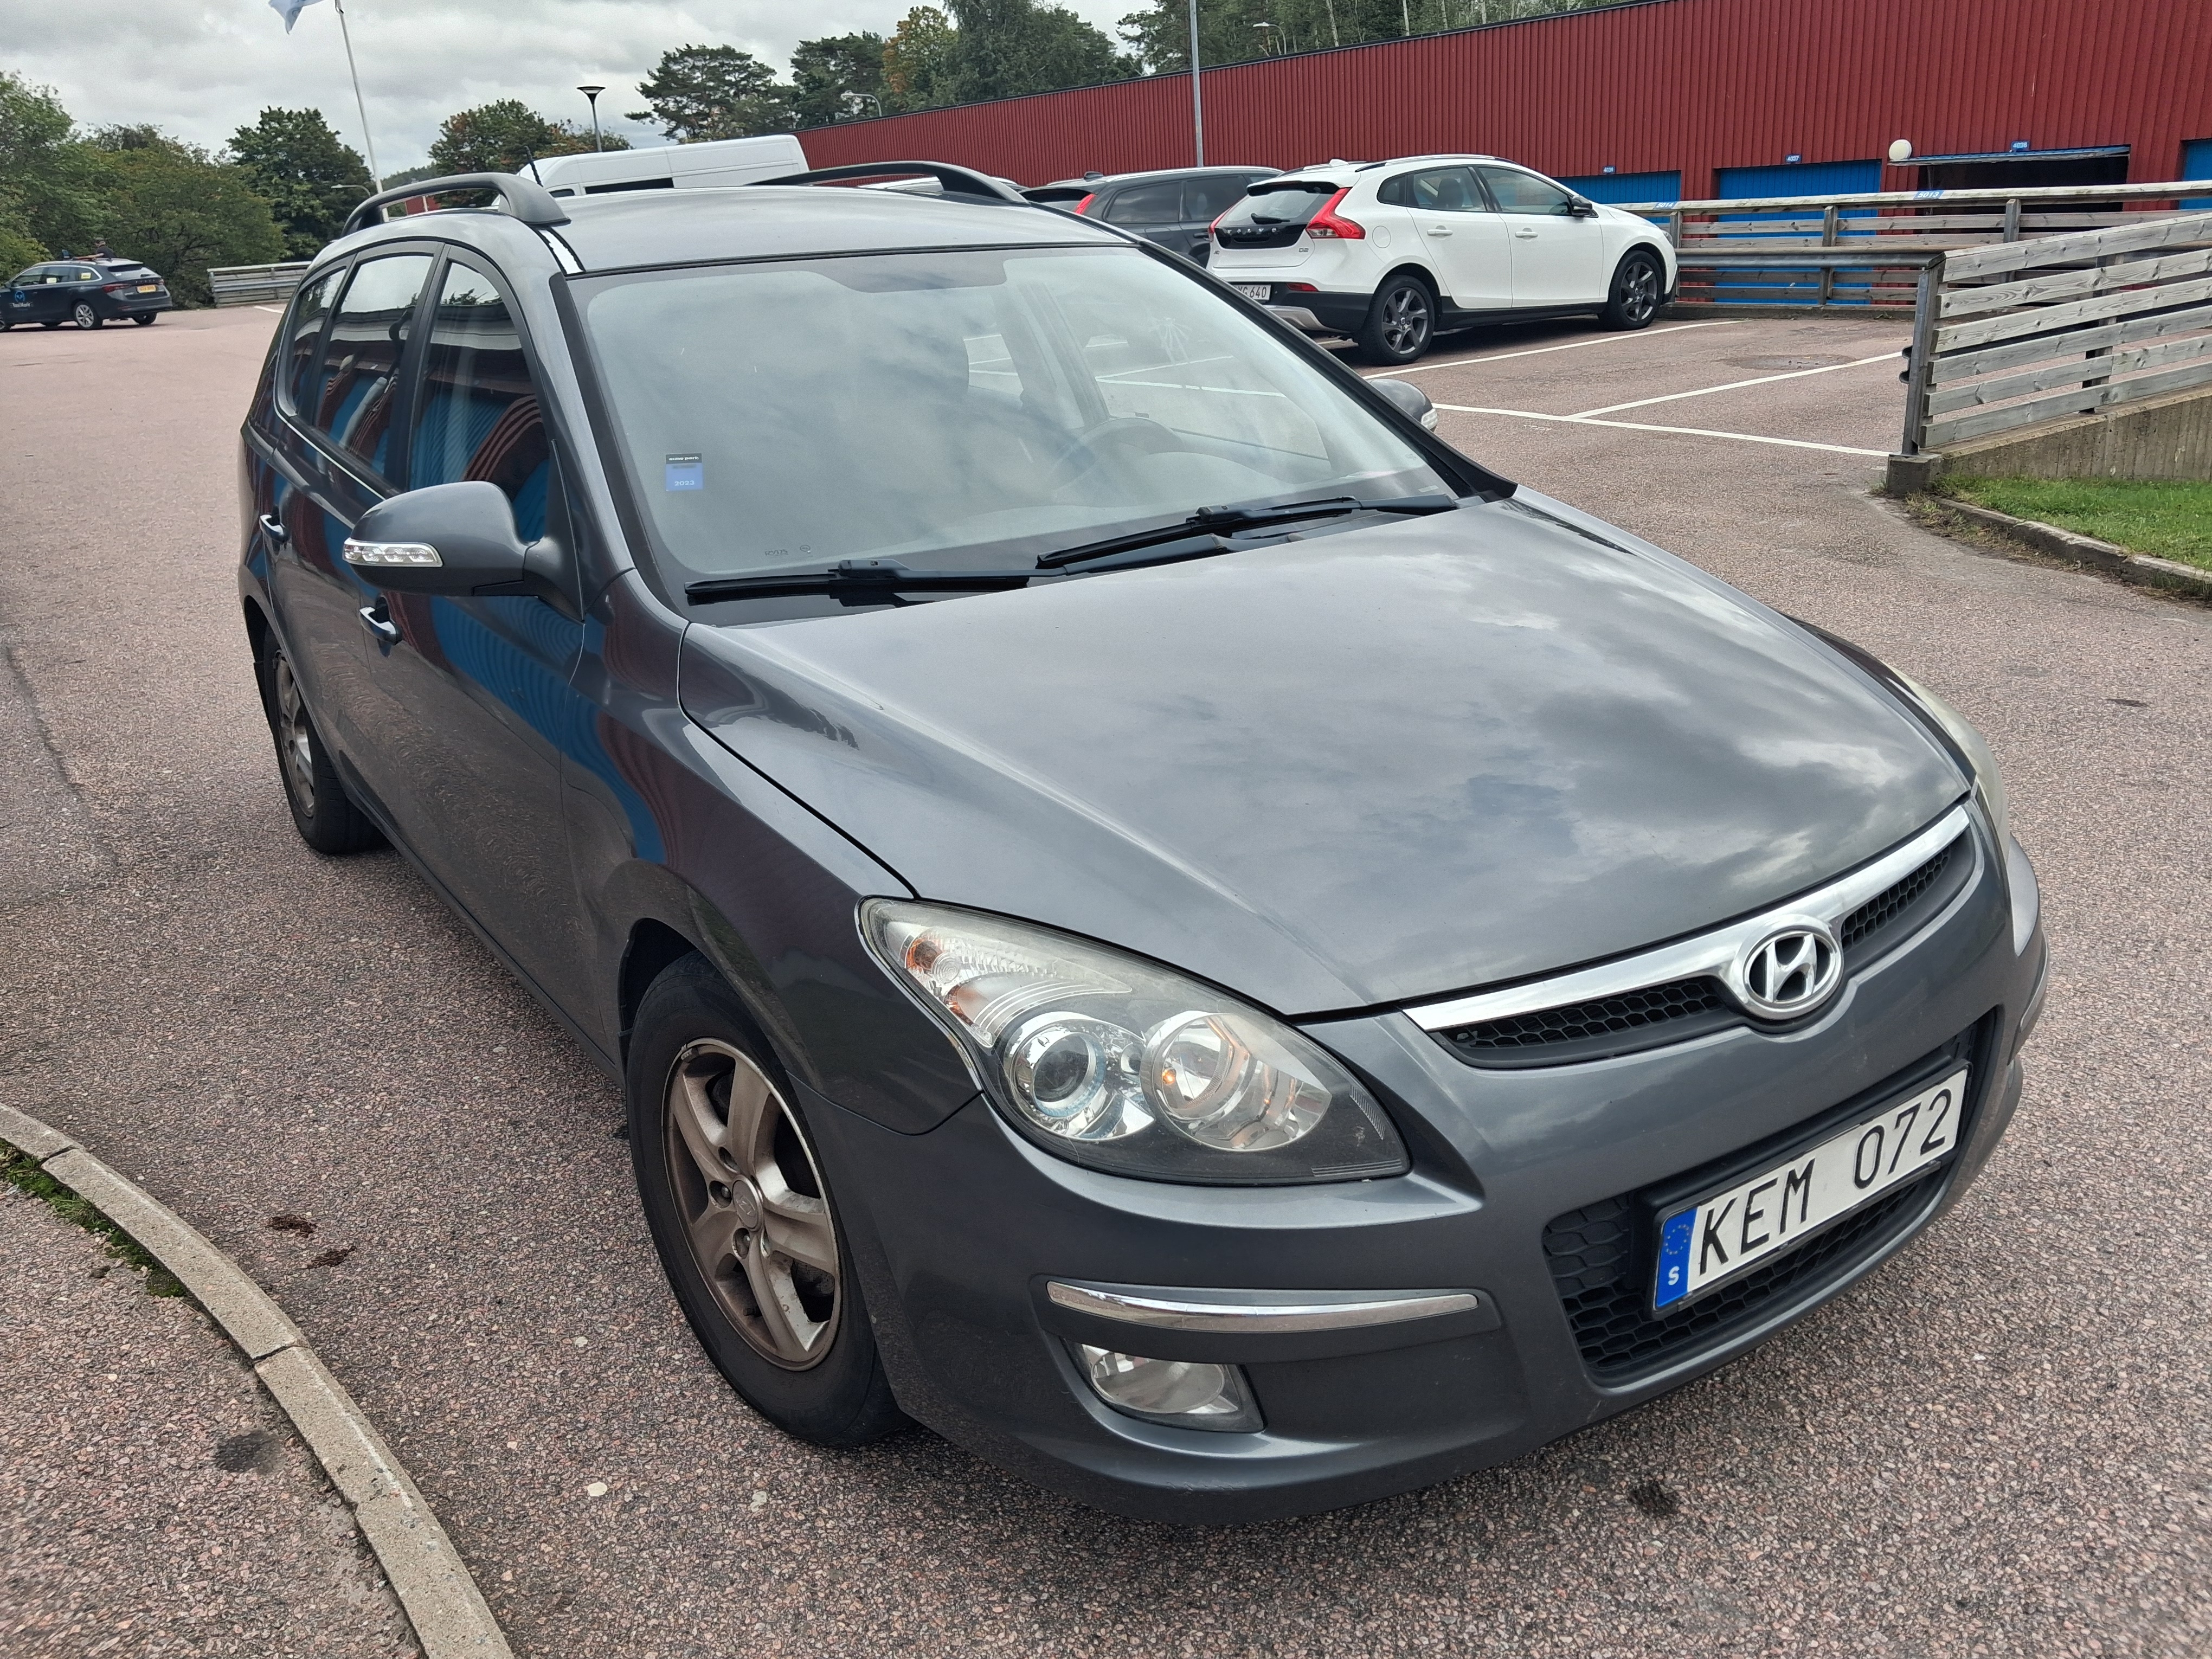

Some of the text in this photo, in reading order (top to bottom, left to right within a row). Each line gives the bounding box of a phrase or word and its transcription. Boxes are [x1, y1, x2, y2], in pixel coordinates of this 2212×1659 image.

[1249, 286, 1267, 298] 640
[1699, 1089, 1952, 1276] KEM 072
[1668, 1265, 1680, 1285] S
